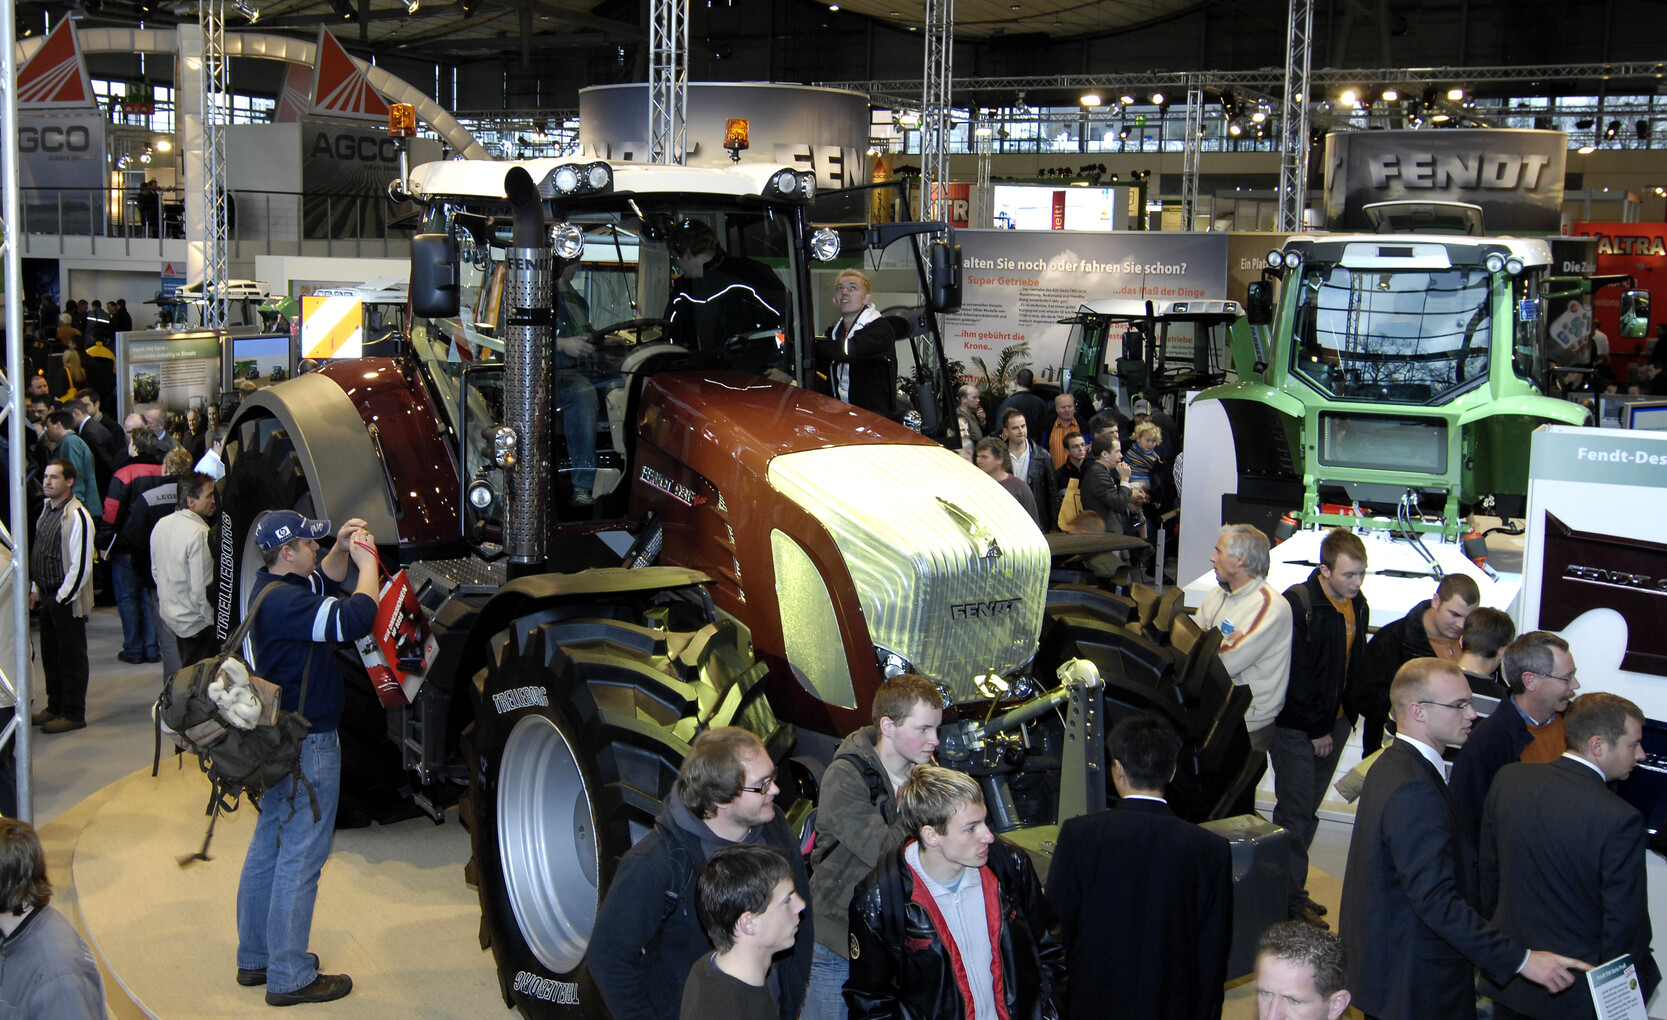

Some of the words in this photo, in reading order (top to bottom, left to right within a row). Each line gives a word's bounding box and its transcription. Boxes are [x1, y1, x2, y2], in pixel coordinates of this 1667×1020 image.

[18, 126, 89, 153] GCO
[311, 132, 400, 163] AGCO
[1369, 154, 1548, 189] FENDT
[1582, 234, 1666, 256] ALTRA
[963, 257, 994, 269] alten
[997, 258, 1015, 270] Sie
[1018, 259, 1046, 271] noch
[1050, 260, 1078, 272] oder
[1080, 260, 1120, 273] fahren
[1123, 261, 1142, 274] Sie
[1144, 262, 1187, 275] schon?
[1241, 258, 1251, 270] Ein
[1563, 261, 1580, 273] Die
[967, 275, 995, 287] Super
[998, 276, 1040, 287] Getriebe
[1112, 285, 1137, 295] ...das
[1139, 287, 1159, 296] Maß
[1161, 287, 1176, 296] der
[1178, 288, 1206, 299] Dinge
[978, 331, 1011, 341] gebührt
[1013, 332, 1025, 341] die
[1167, 336, 1193, 344] etriebe
[216, 511, 234, 640] TRELLEBORG
[951, 597, 1023, 620] FENDT
[492, 686, 549, 714] TRELLEBORG
[513, 970, 580, 1005] TRELLEBORG
